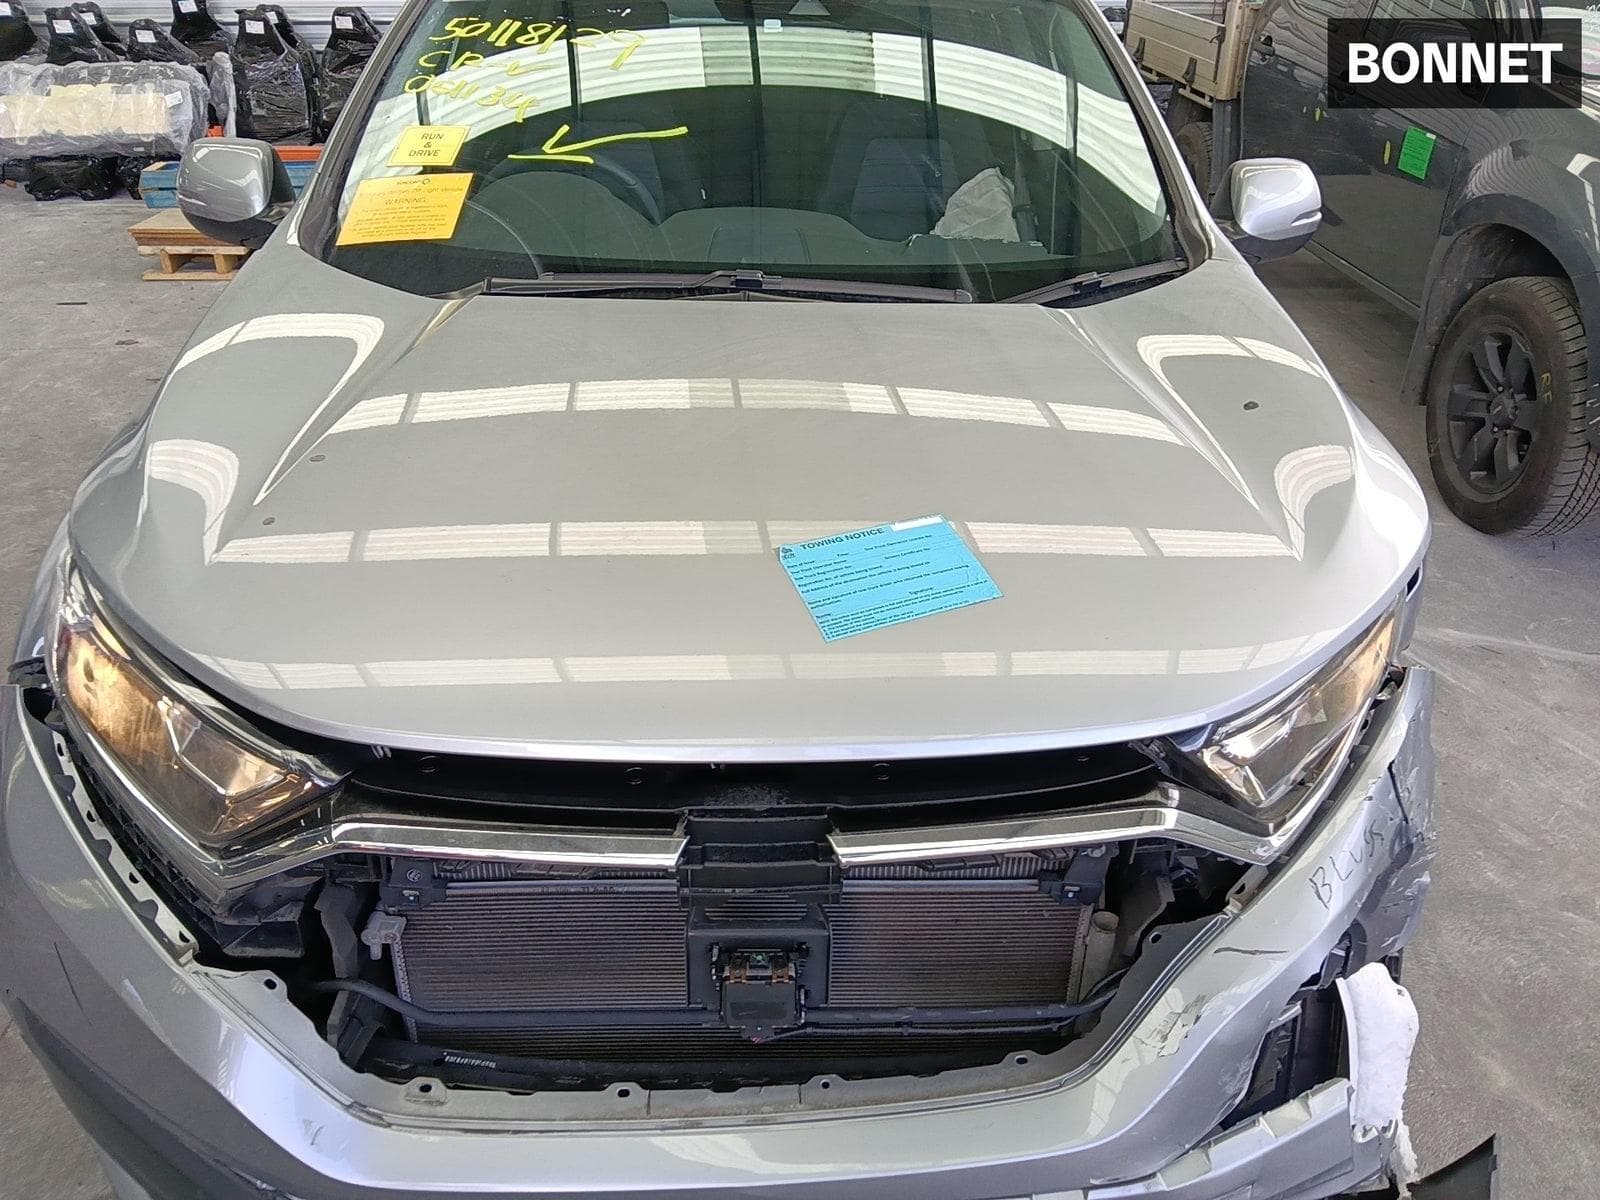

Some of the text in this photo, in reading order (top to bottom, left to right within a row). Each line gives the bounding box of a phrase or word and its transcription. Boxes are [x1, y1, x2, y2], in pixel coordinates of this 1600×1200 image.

[421, 132, 445, 140] RUN
[408, 149, 441, 157] DRIVE
[799, 536, 844, 551] TOWING
[844, 527, 885, 544] NOTICE
